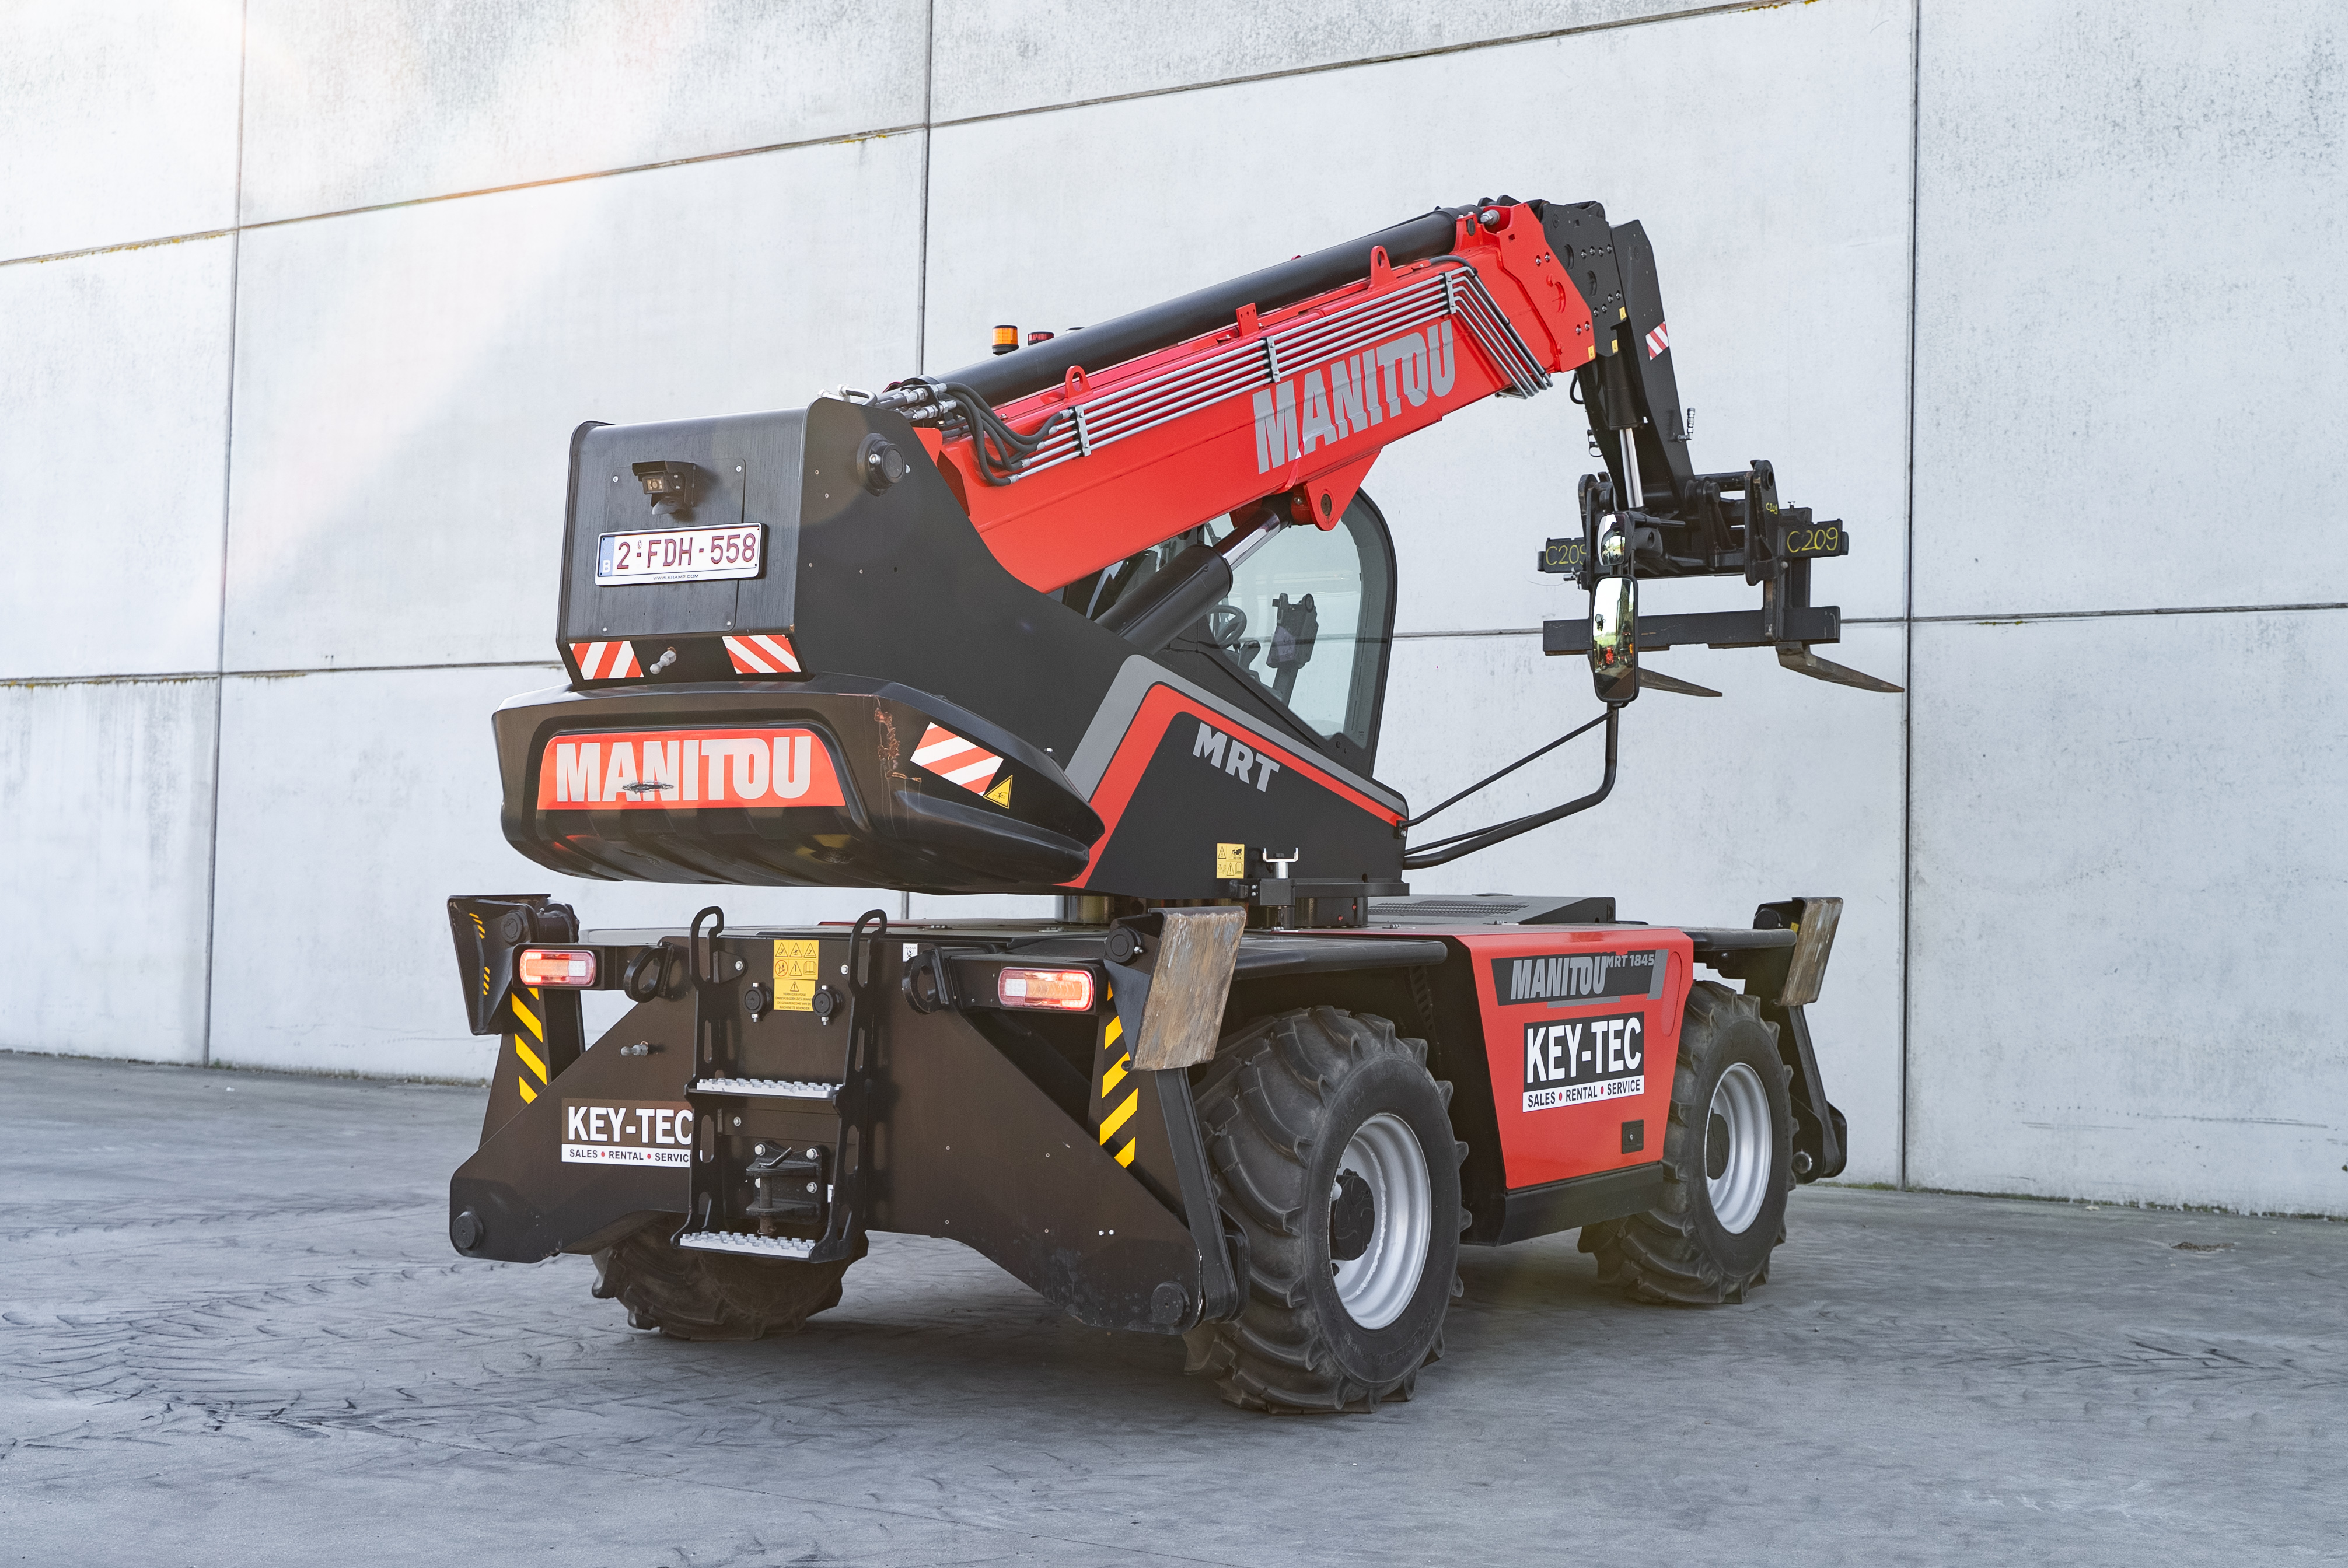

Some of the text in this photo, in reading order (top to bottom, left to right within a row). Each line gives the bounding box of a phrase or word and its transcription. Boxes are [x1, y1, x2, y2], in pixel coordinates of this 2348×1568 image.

[1252, 319, 1455, 474] MANITOU
[1787, 527, 1838, 552] C209
[602, 559, 611, 573] B
[555, 736, 812, 802] MANITOU
[1192, 722, 1280, 793] MRT
[1510, 954, 1655, 1000] MANITOU MRT 1845
[1527, 1017, 1641, 1083] KEY-TEC
[1528, 1079, 1640, 1108] SALES RENTAL SERVICE
[568, 1106, 693, 1145] KEY-TEC
[569, 1149, 689, 1163] SALES RENTAL SERVIC
